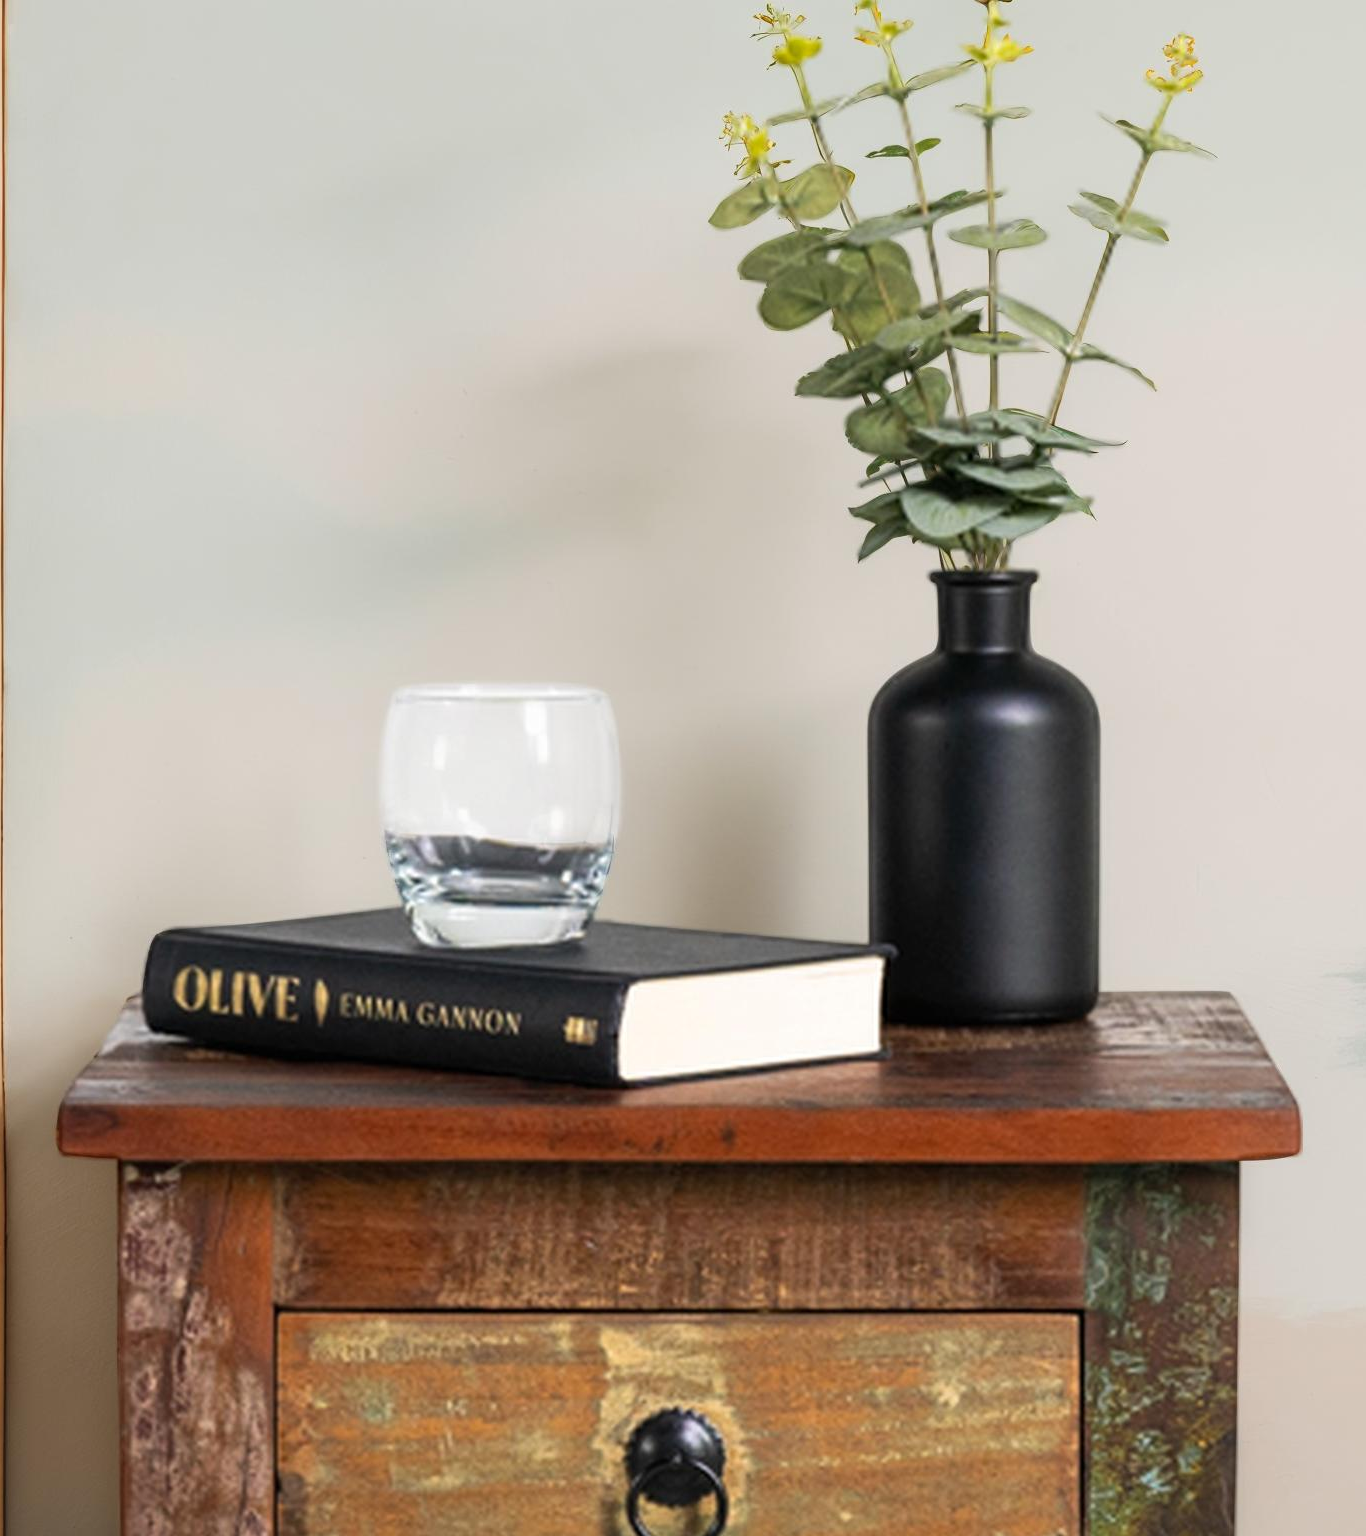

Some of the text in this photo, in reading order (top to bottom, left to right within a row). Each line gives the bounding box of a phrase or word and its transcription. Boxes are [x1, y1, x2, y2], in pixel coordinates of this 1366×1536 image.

[173, 965, 522, 1035] OLIVE EMMA GANNON
